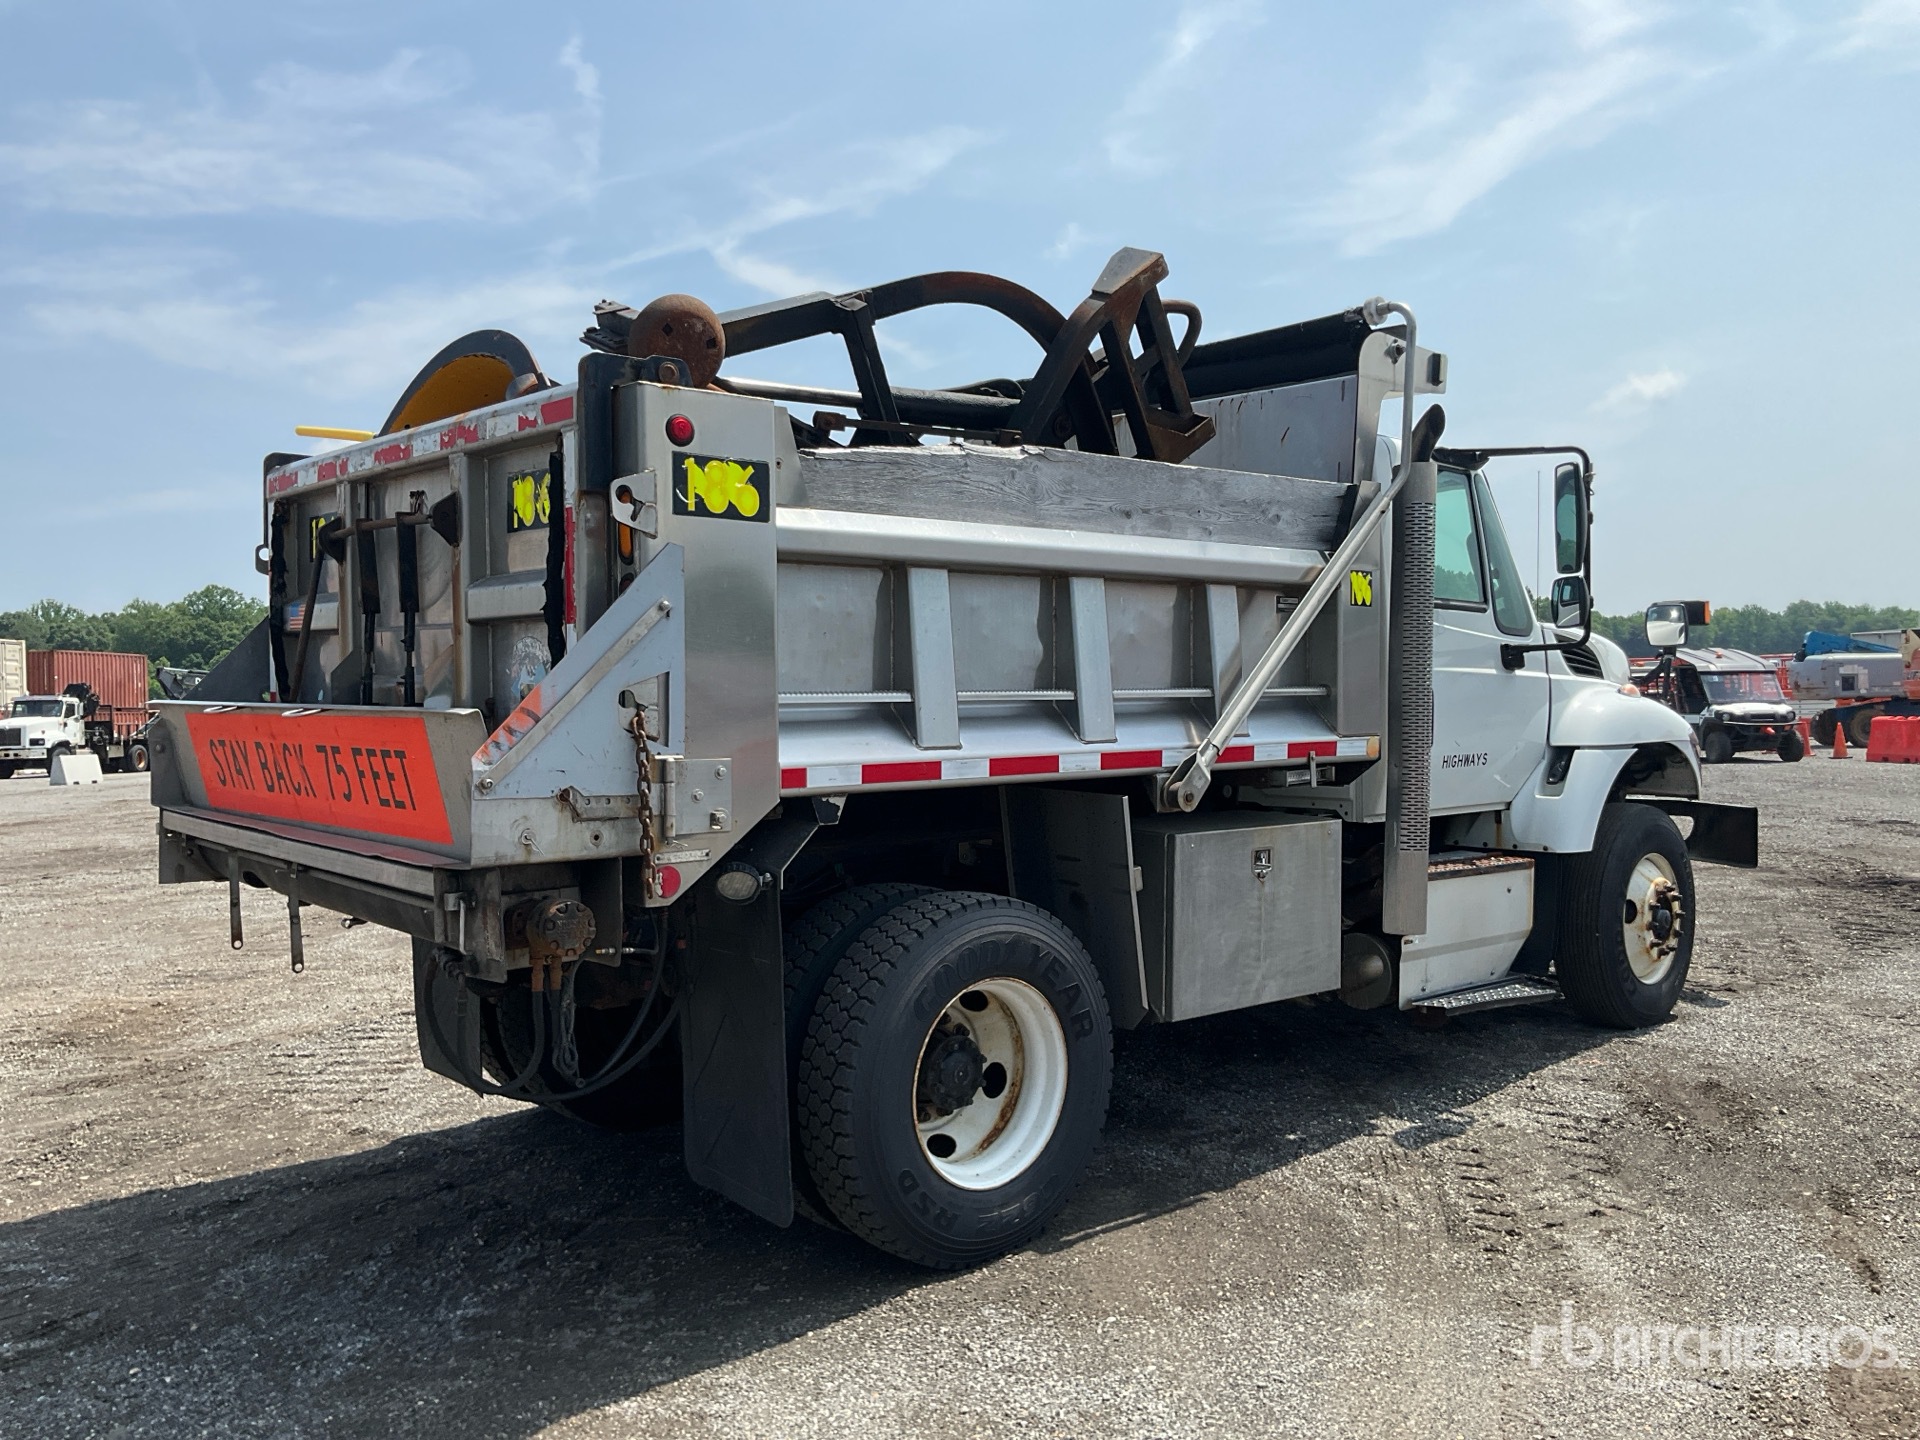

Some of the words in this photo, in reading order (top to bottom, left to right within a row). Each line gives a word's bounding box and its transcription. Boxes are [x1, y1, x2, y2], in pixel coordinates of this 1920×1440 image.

[210, 739, 255, 791] STAY
[254, 741, 317, 798] BACK
[315, 744, 352, 803] 75
[351, 746, 416, 811] FEET
[1442, 752, 1488, 769] HIGHWAYS
